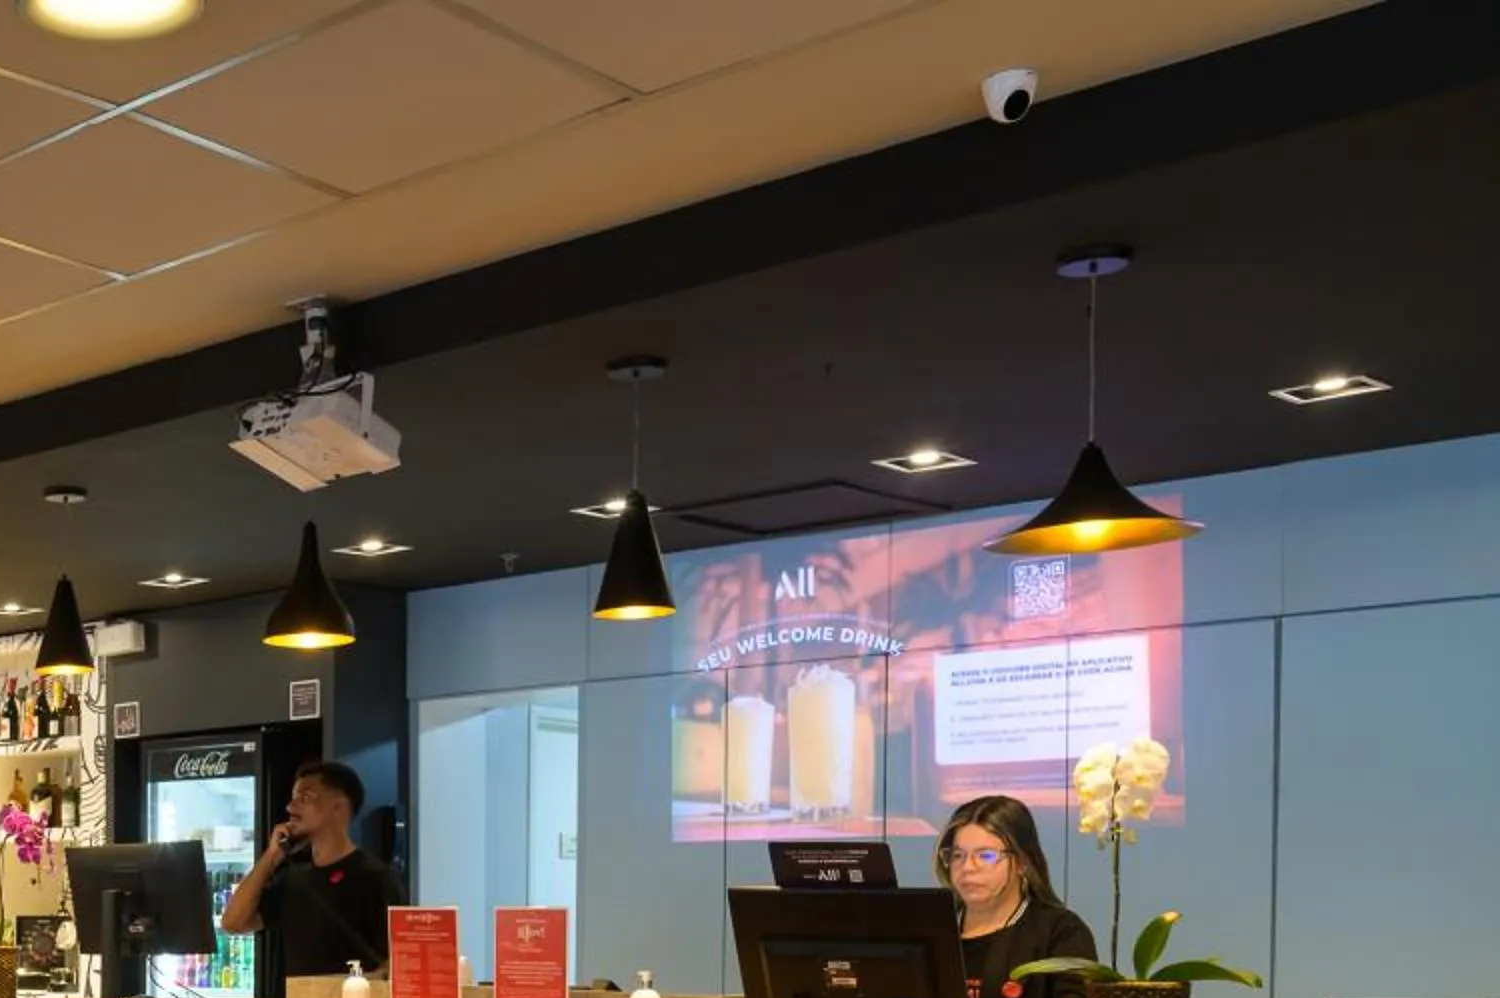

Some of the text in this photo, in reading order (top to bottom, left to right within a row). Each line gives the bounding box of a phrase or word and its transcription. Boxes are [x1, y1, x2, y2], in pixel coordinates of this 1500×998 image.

[697, 626, 905, 673] SEU WELCOME DRINK
